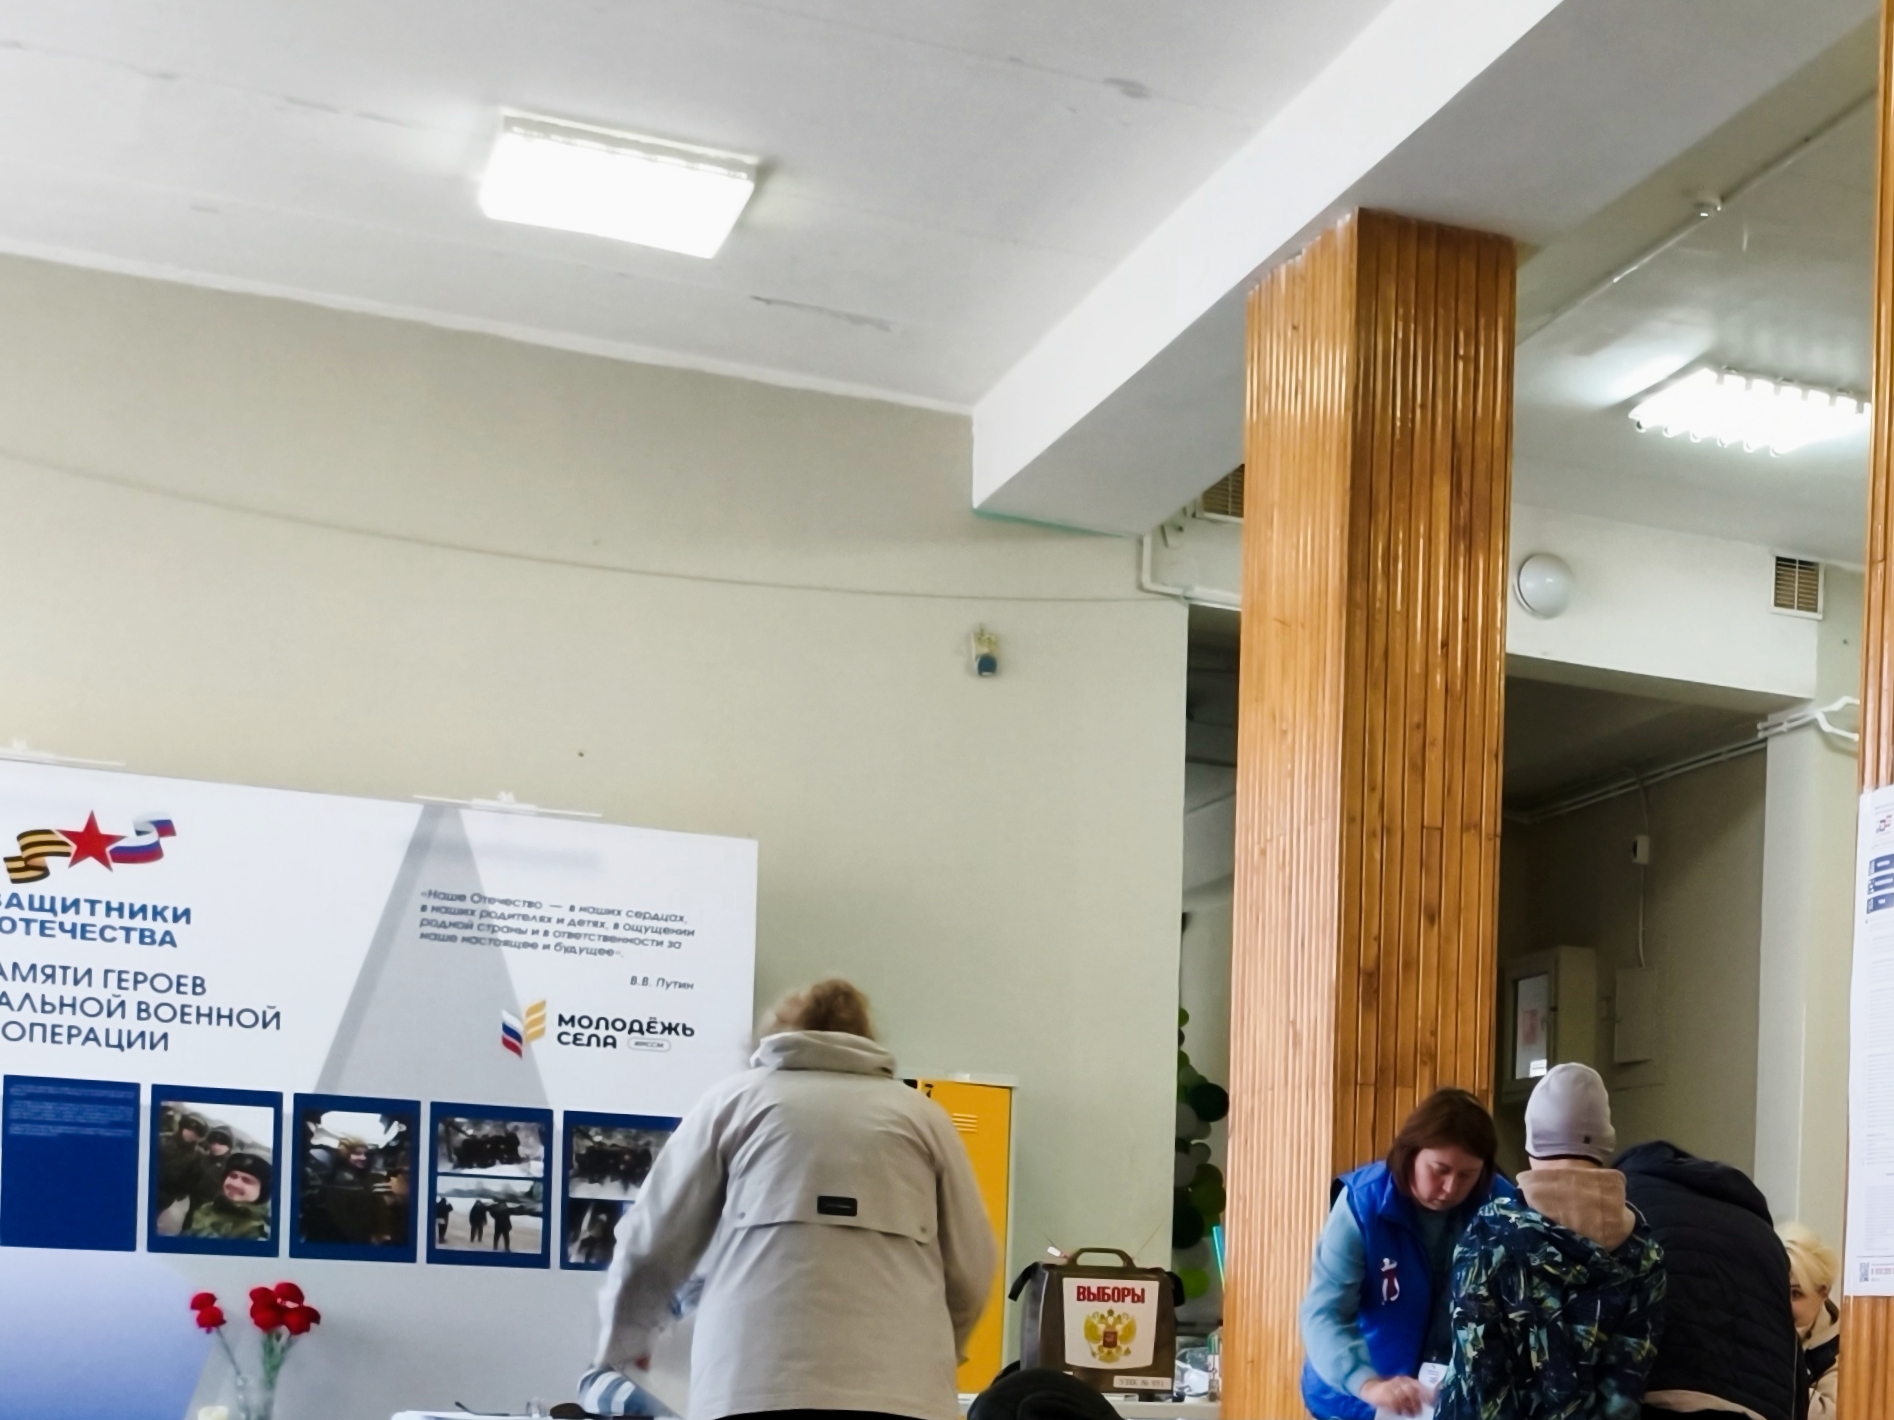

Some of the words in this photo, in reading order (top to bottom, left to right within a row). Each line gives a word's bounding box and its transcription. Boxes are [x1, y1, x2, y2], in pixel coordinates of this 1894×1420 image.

[0, 892, 191, 925] АЩИТНИКИ
[470, 893, 542, 909] Отечество
[578, 906, 623, 916] наших
[0, 916, 177, 948] ОТЕЧЕСТВА
[420, 917, 474, 931] родной
[477, 923, 528, 935] страны
[553, 930, 664, 947] ответственности
[667, 940, 682, 950] за
[431, 905, 477, 917] наших
[479, 910, 553, 924] родителях
[623, 923, 695, 937] ощущении
[420, 932, 458, 943] наше
[461, 936, 539, 950] настоящее
[103, 968, 206, 996] ГЕРОЕВ
[656, 978, 694, 991] Путин
[137, 1001, 281, 1031] ВОЕННОЙ
[557, 1013, 695, 1037] МОЛОДЁЖЬ
[1, 1020, 169, 1052] ОПЕРАЦИИ
[557, 1031, 617, 1049] СЕЛА
[1076, 1285, 1145, 1304] ВЫБОРЫ
